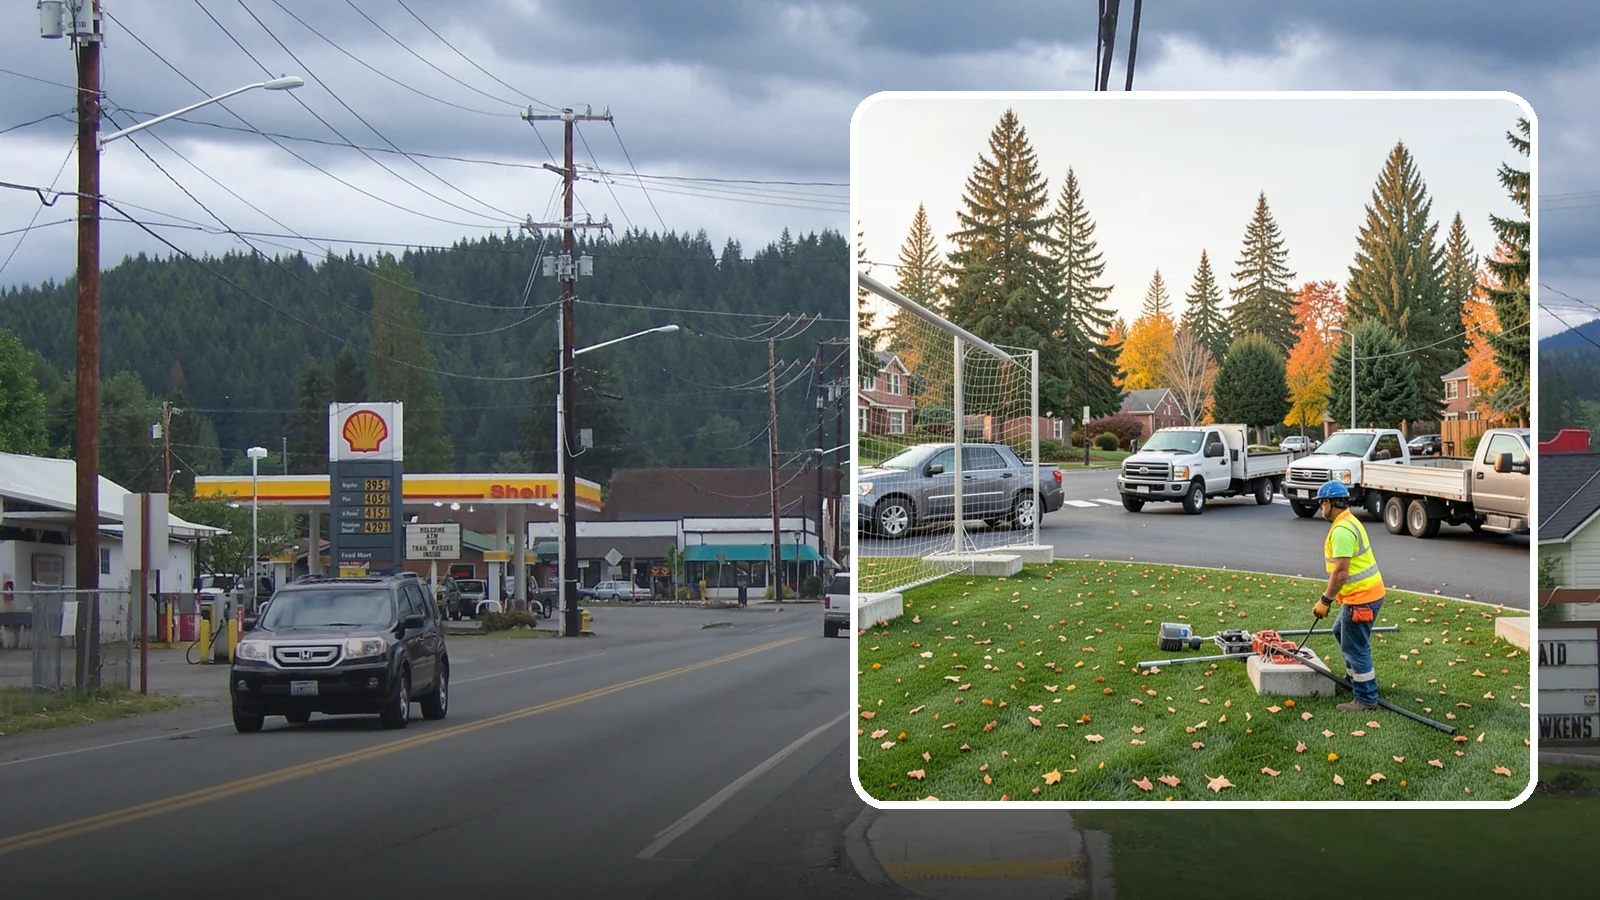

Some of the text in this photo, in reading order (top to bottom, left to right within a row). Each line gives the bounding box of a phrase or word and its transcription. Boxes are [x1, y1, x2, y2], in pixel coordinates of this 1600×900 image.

[366, 480, 383, 490] 395
[490, 484, 547, 499] Shell
[366, 494, 383, 504] 405
[366, 508, 383, 518] 415
[366, 522, 383, 532] 429
